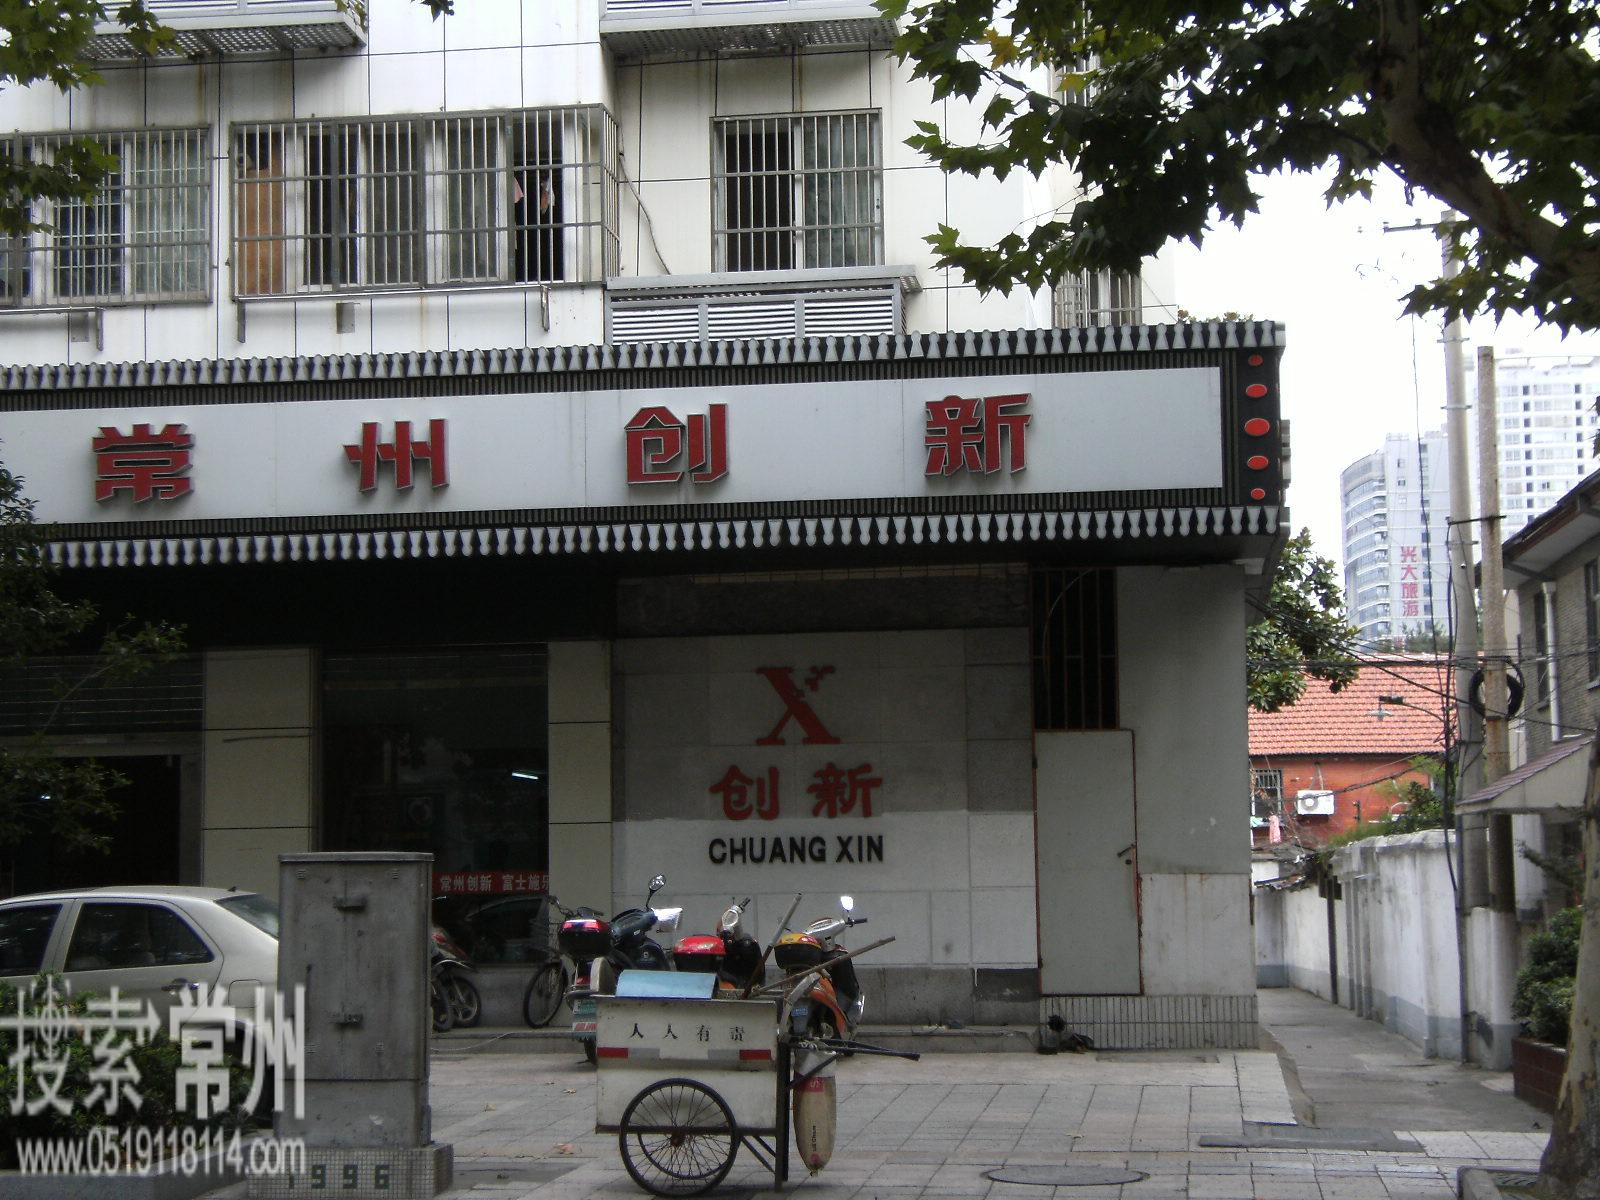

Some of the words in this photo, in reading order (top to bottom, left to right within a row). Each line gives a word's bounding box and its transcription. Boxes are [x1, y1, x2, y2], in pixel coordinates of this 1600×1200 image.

[91, 393, 1033, 504] 常州创新
[708, 762, 883, 821] 创新
[708, 835, 827, 864] CHUANG
[836, 834, 884, 863] XIN
[439, 874, 493, 892] 常州创新
